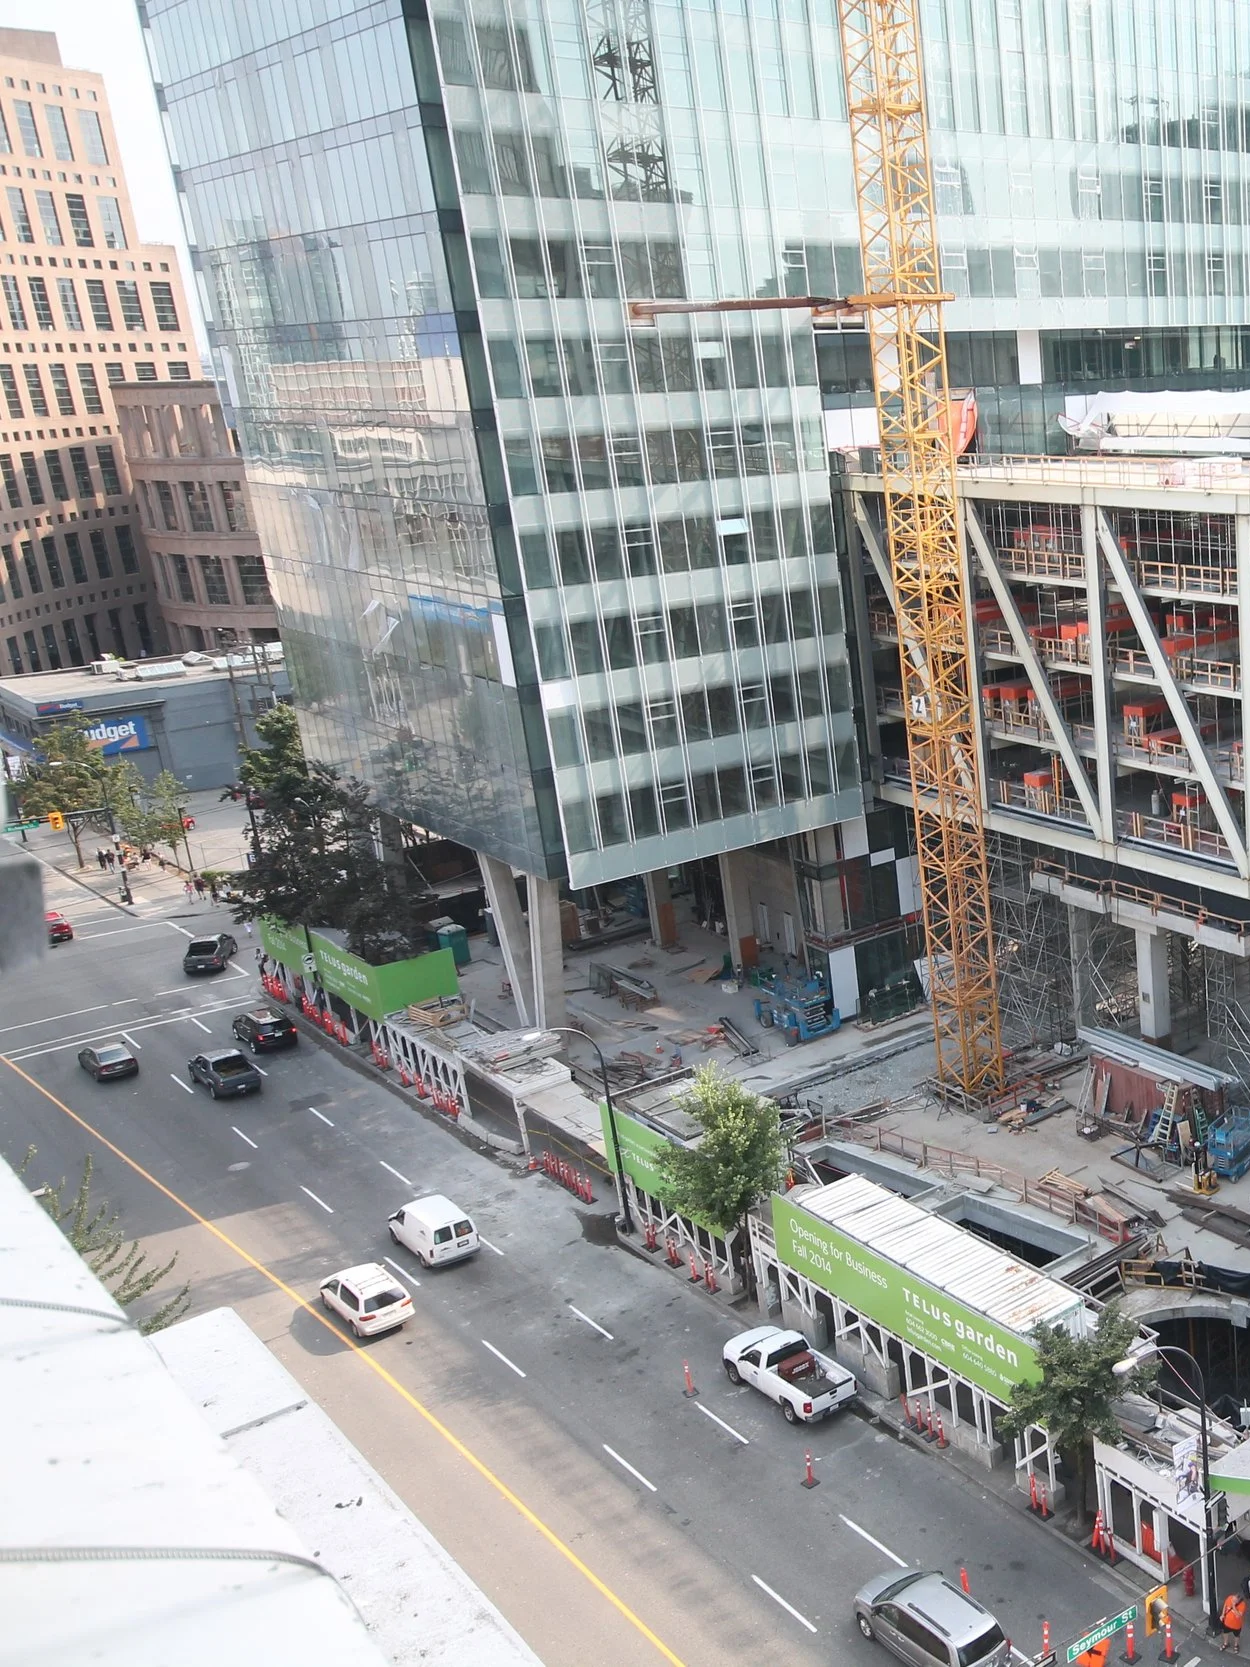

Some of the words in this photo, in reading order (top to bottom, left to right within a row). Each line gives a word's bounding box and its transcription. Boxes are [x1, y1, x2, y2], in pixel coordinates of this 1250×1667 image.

[915, 698, 923, 714] 2
[84, 721, 137, 742] udget
[319, 949, 341, 970] TELUS
[341, 962, 369, 985] garden
[631, 1151, 655, 1172] TELUS
[789, 1218, 829, 1255] Opening
[829, 1242, 843, 1262] for
[845, 1251, 888, 1289] Business
[792, 1239, 808, 1260] Fall
[808, 1250, 833, 1275] 2014
[902, 1287, 952, 1328] TELUS
[954, 1319, 1018, 1368] garden
[1072, 1621, 1118, 1656] Seymour
[1121, 1610, 1133, 1624] St
